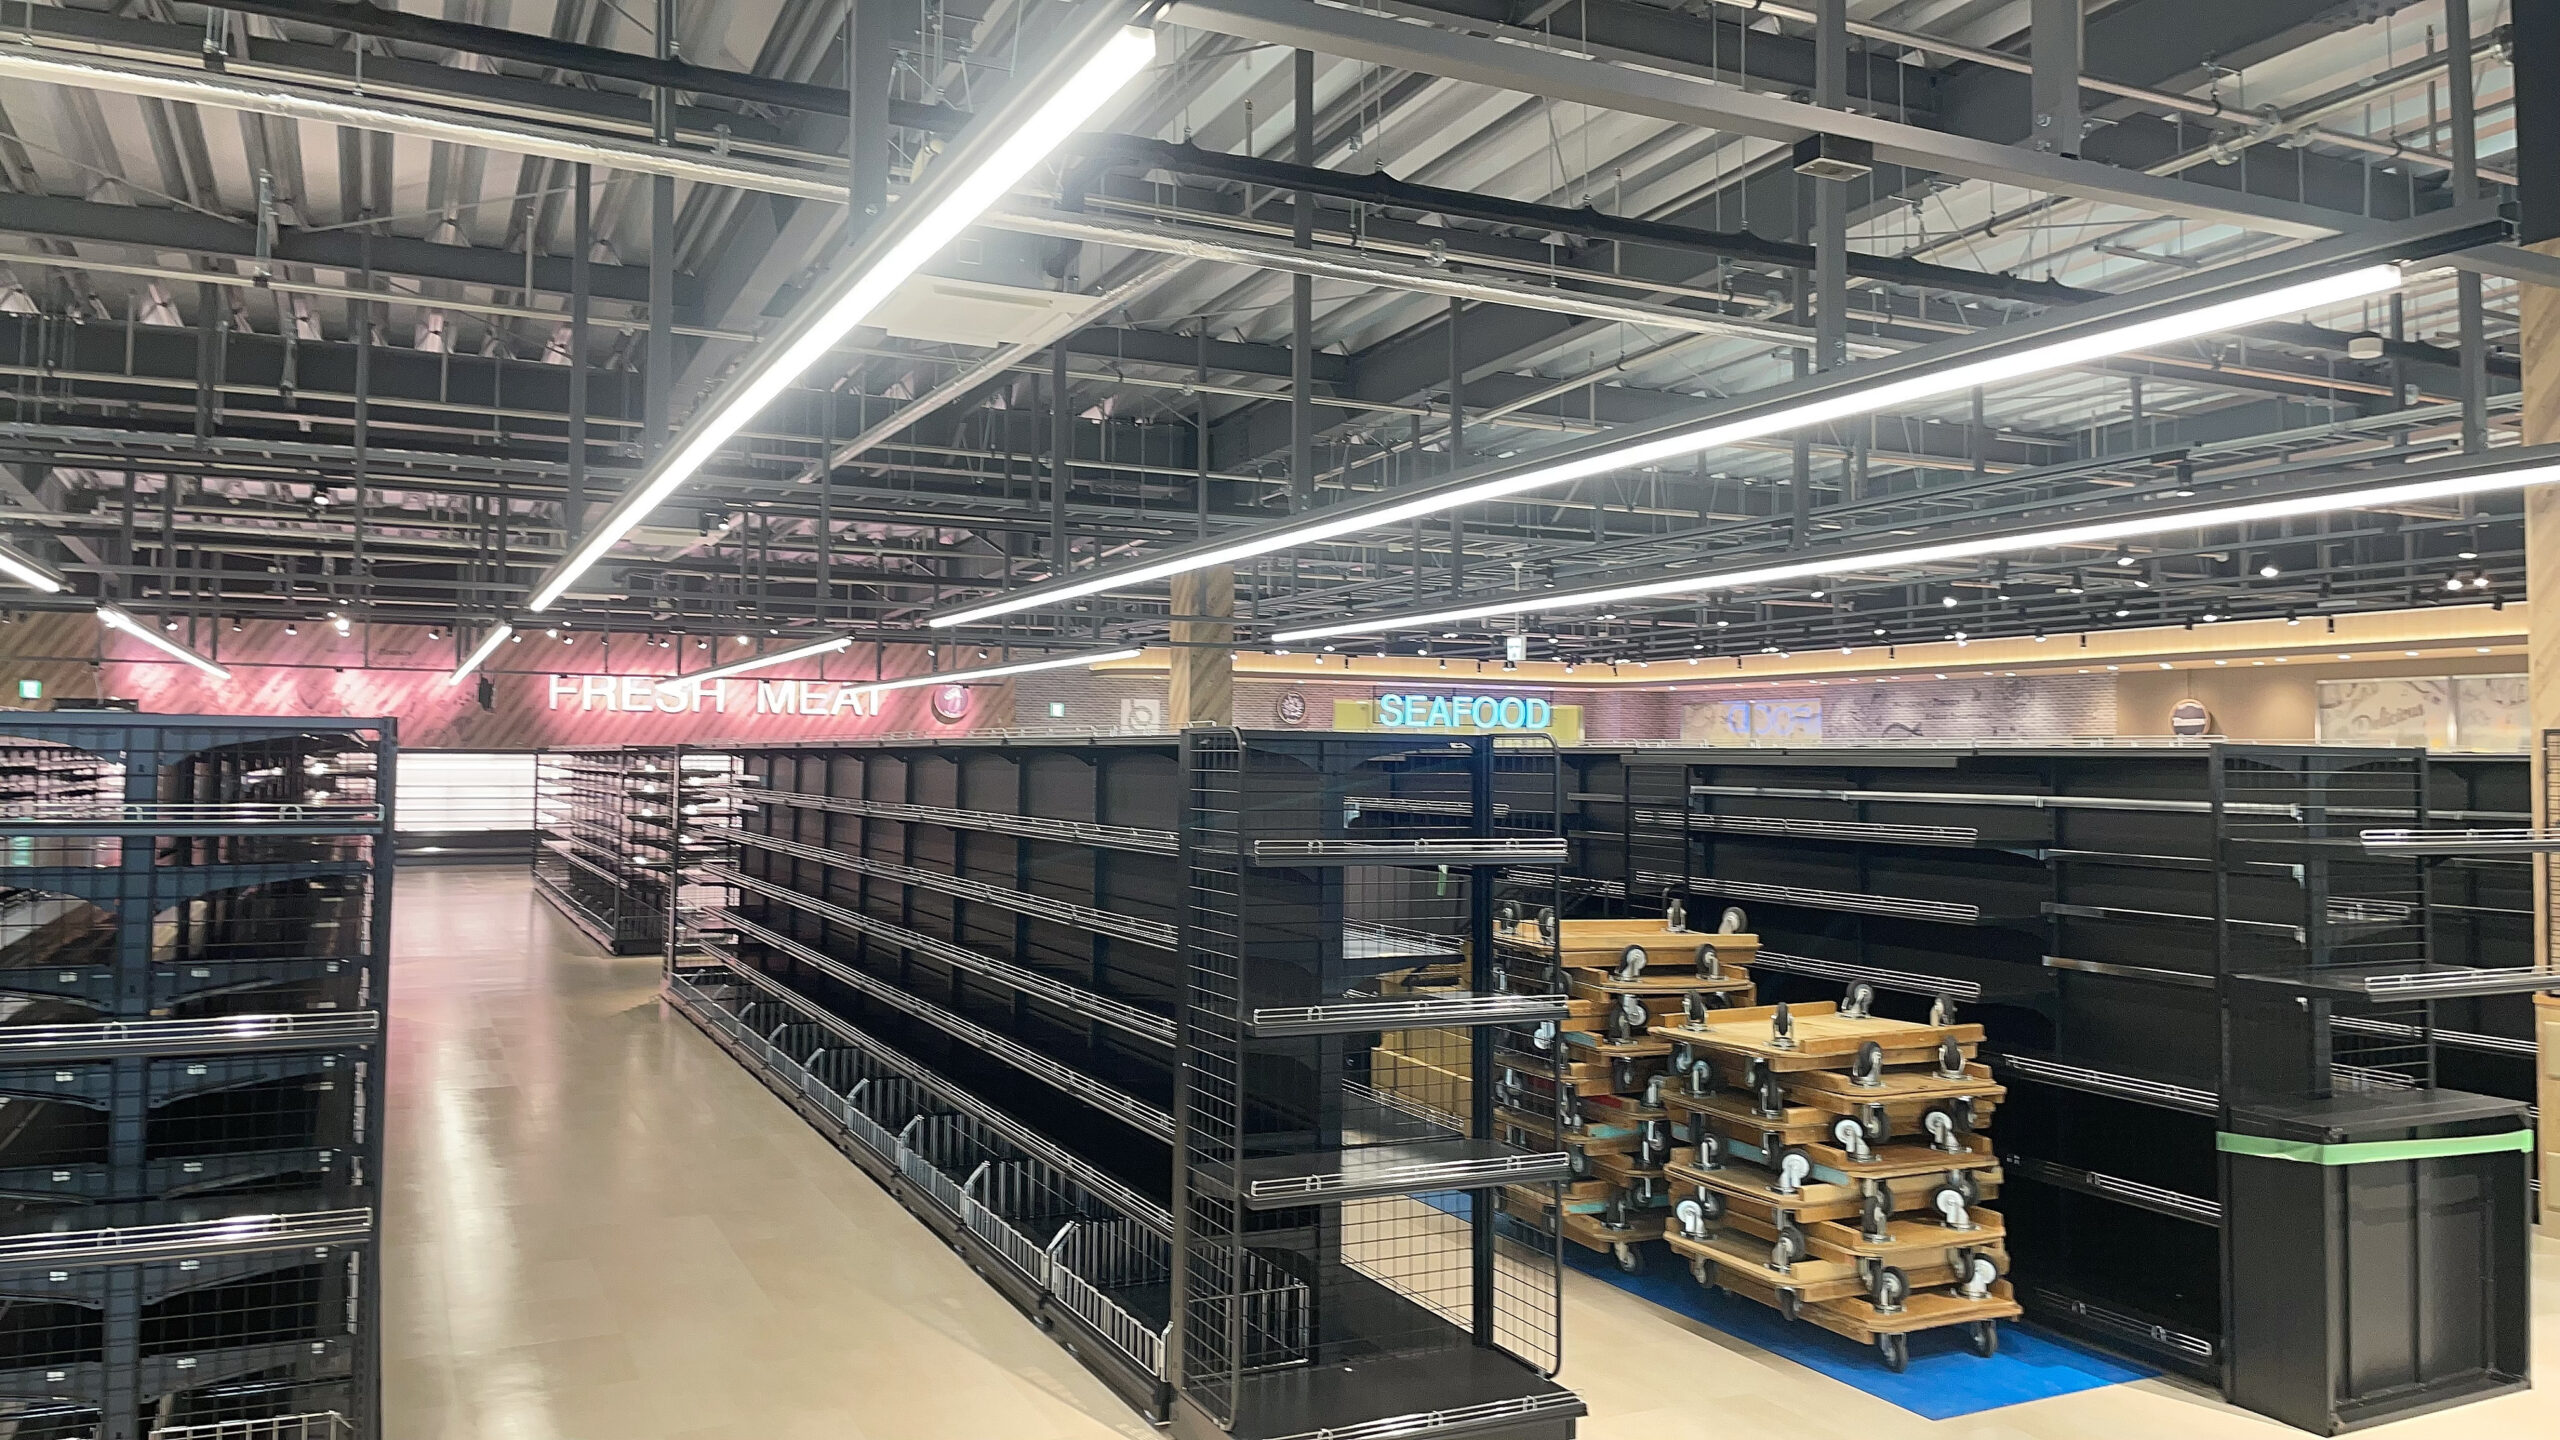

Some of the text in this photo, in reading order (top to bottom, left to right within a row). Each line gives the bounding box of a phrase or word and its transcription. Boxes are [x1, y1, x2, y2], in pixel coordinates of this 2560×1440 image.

[549, 674, 882, 717] FRESH MEAT
[1379, 693, 1552, 730] SEAFOOD
